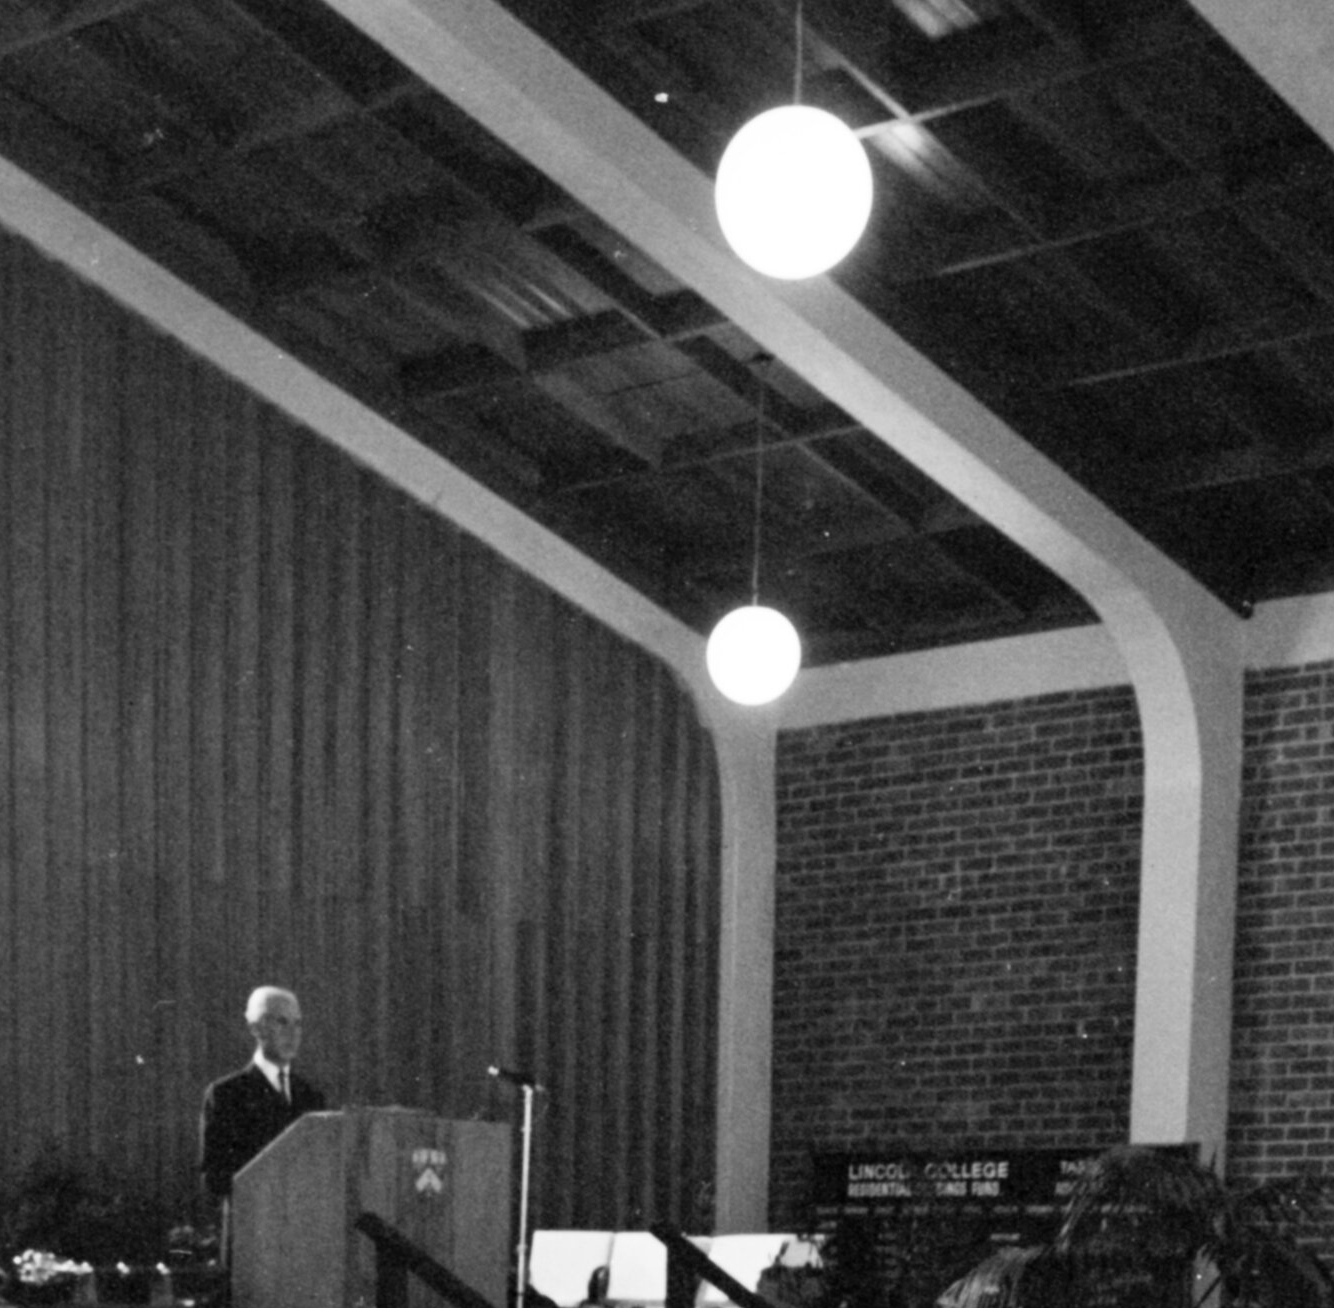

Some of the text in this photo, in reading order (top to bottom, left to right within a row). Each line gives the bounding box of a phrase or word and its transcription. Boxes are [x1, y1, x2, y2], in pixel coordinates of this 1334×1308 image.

[848, 1161, 1009, 1180] LINCOL COLLEGE
[971, 1181, 1001, 1197] FUND
